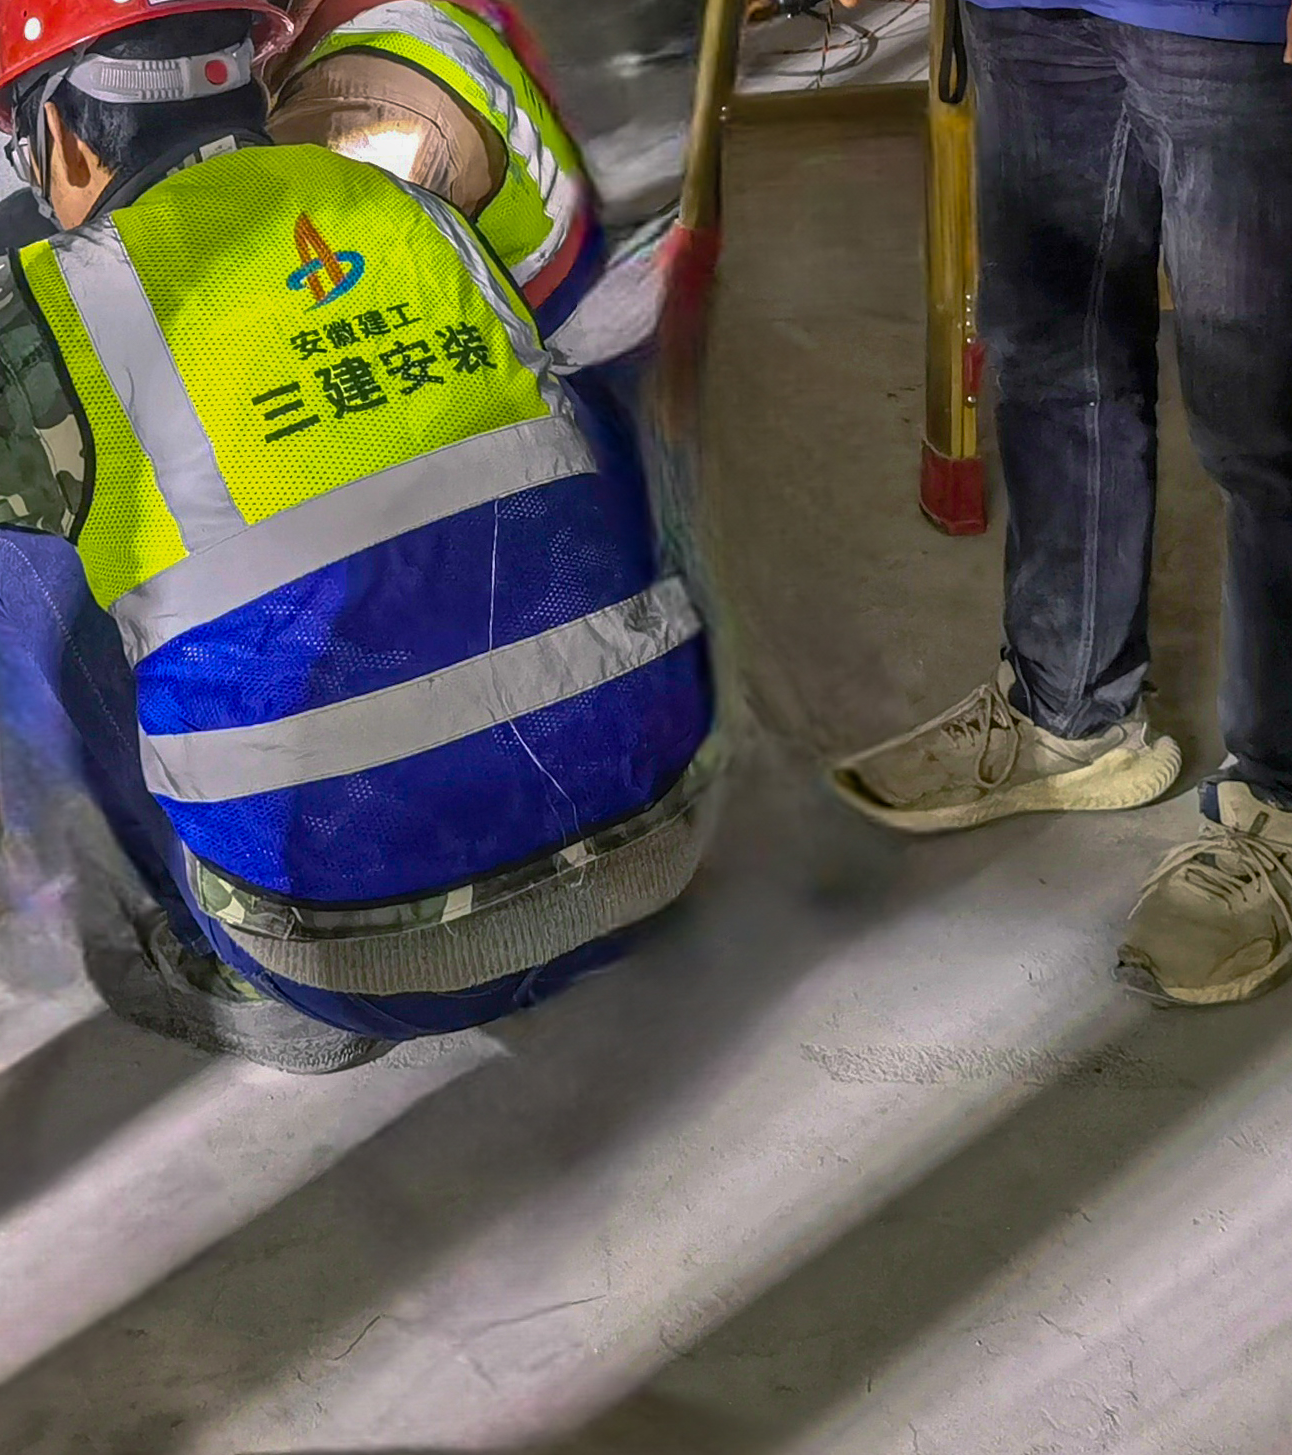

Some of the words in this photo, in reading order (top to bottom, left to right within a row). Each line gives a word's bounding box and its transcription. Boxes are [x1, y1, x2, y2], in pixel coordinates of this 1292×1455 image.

[290, 302, 423, 360] 安徽建工
[251, 321, 498, 444] 三建安装
